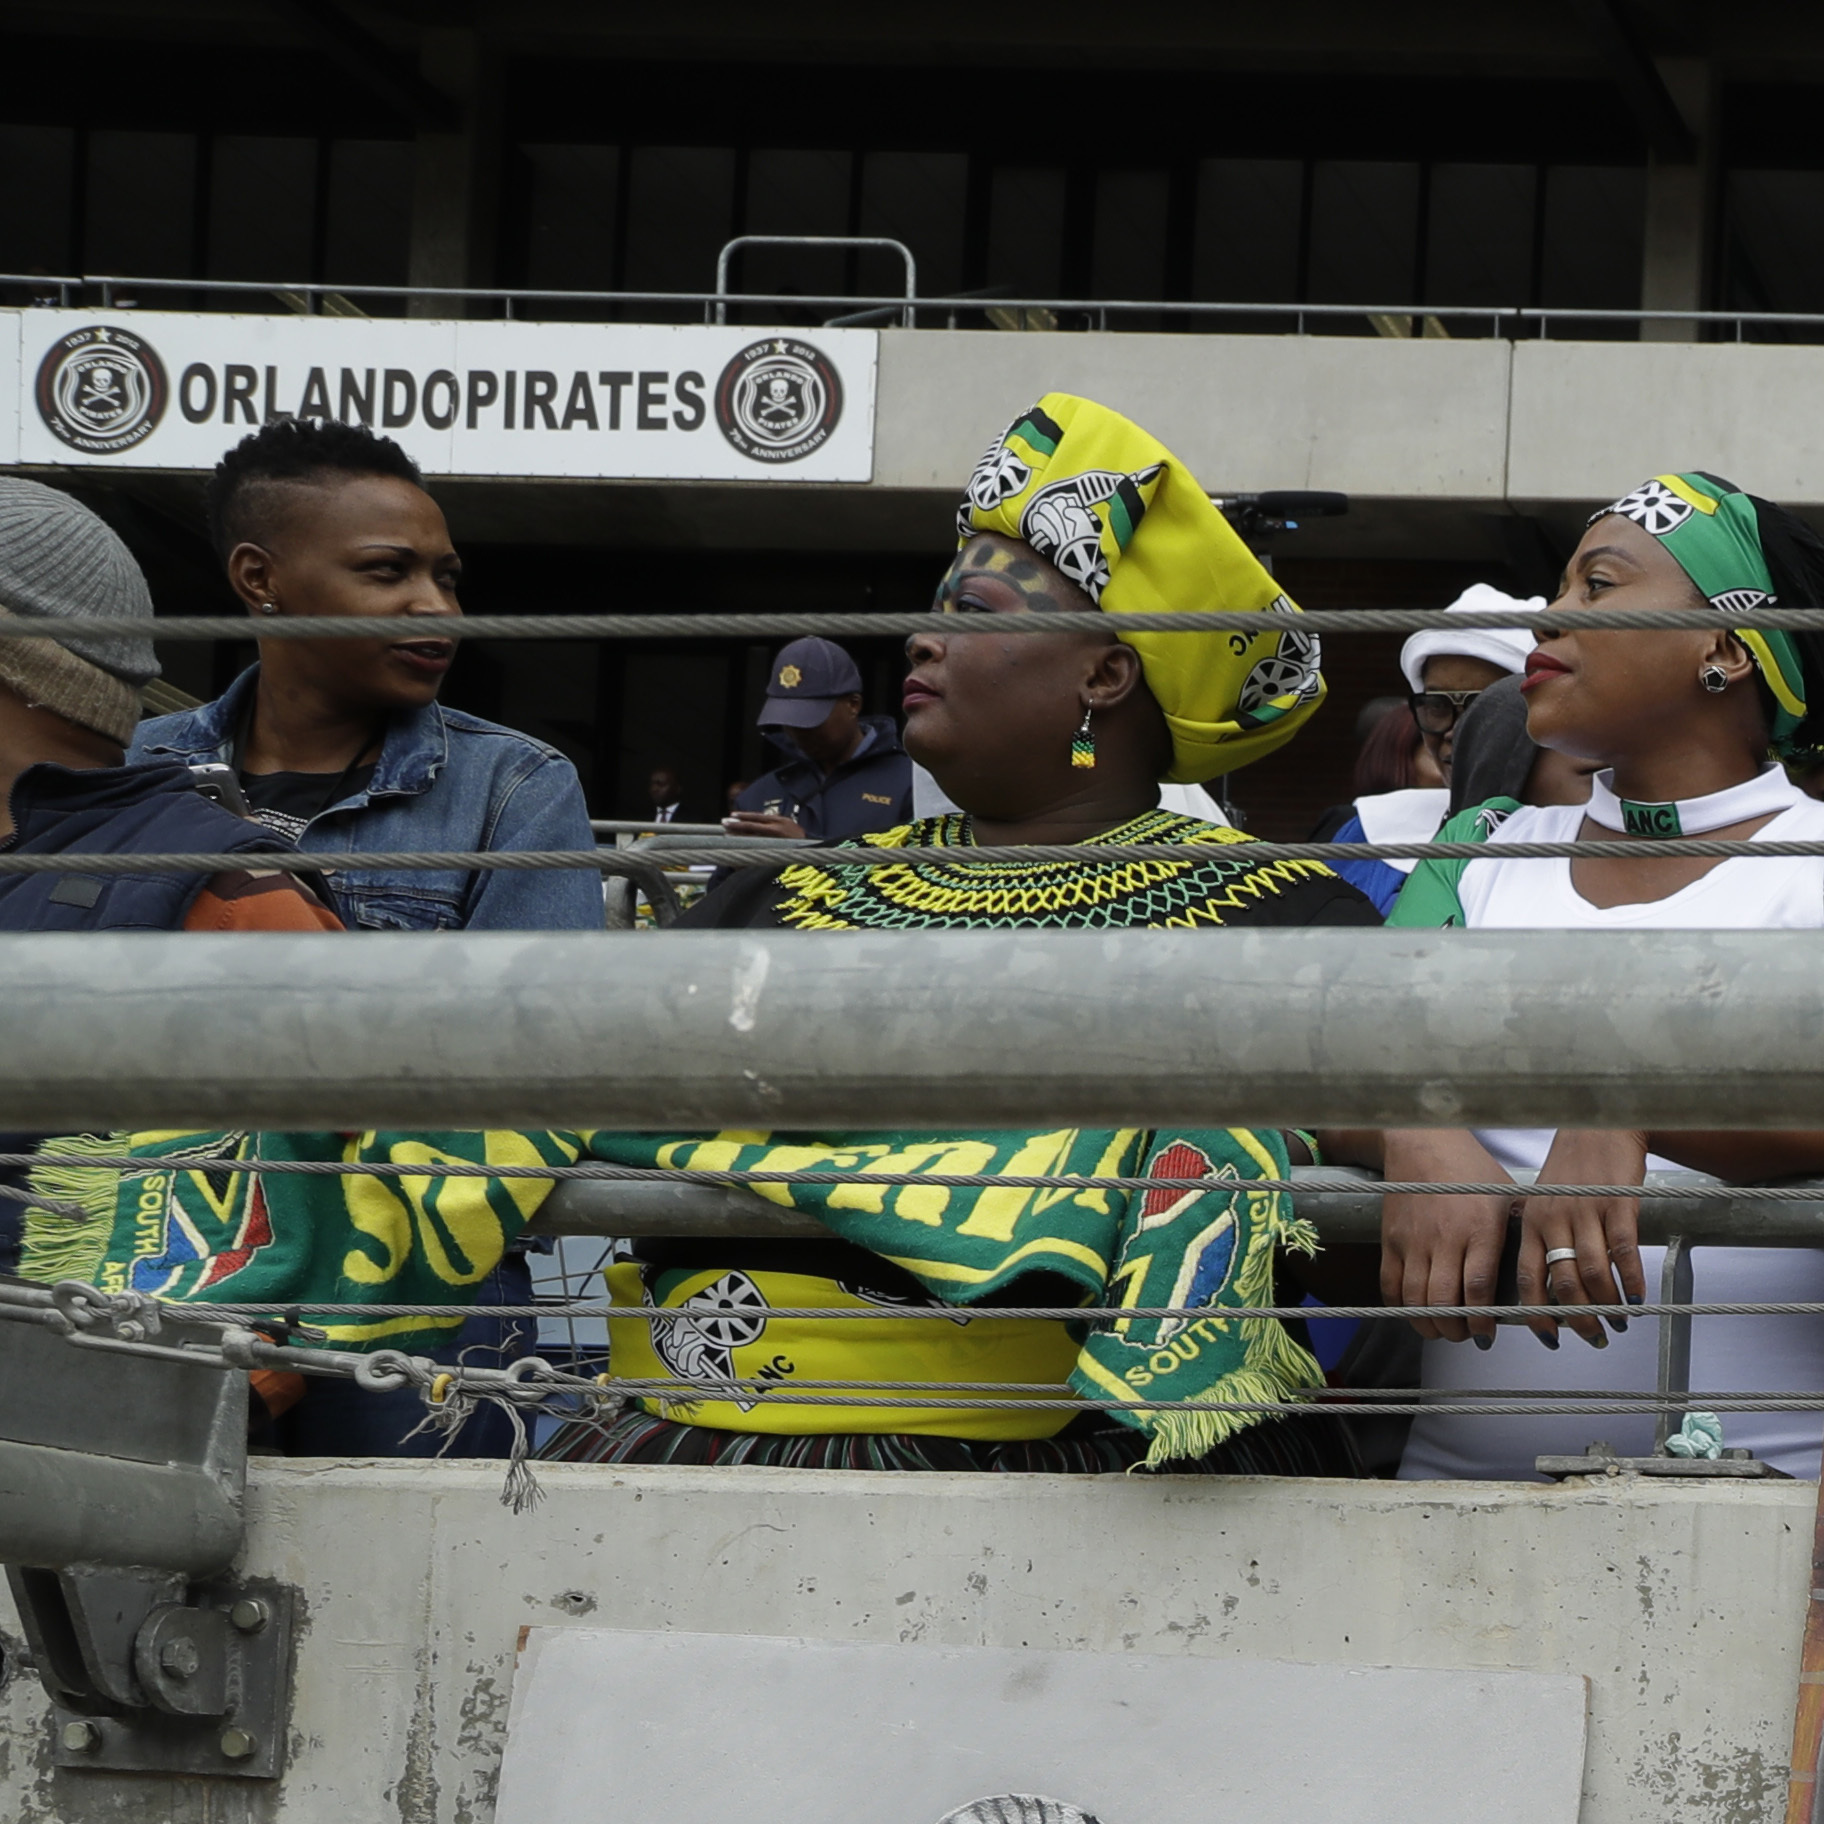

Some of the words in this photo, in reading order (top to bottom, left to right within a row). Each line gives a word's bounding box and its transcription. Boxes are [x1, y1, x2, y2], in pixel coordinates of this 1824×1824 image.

[755, 371, 804, 385] ORLANDO
[74, 420, 153, 449] ANNIVERSARY
[757, 417, 800, 430] PIRATES
[751, 428, 827, 459] ANNIVERSARY
[861, 792, 892, 806] POLICE
[1626, 809, 1673, 833] ANC
[133, 1175, 167, 1255] SOUTH
